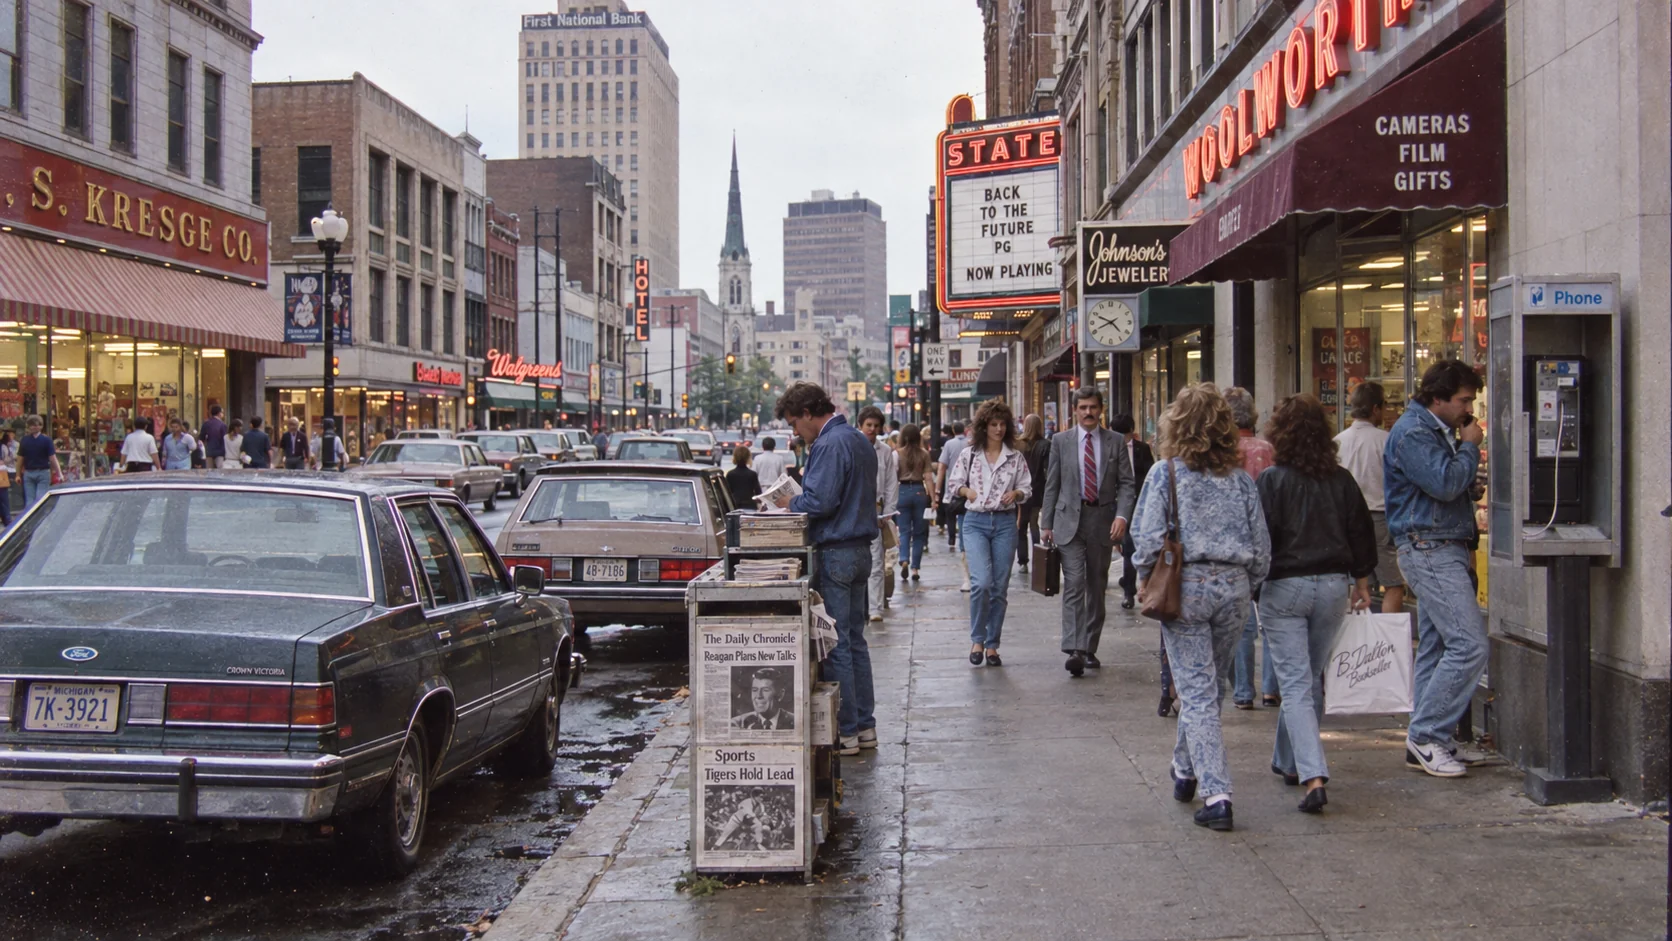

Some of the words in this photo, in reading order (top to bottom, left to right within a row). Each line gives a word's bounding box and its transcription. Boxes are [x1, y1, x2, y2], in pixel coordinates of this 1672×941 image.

[523, 14, 552, 28] First
[557, 12, 606, 27] National
[611, 12, 642, 25] Bank
[1375, 114, 1470, 136] CAMERAS
[948, 131, 1055, 167] STATE
[1399, 143, 1446, 163] FILM
[1394, 170, 1451, 192] GIFTS
[984, 185, 1020, 202] BACK
[32, 166, 68, 217] S.
[85, 181, 213, 254] KRESGE
[222, 224, 259, 265] CO.
[980, 206, 997, 220] TO
[1003, 203, 1028, 218] THE
[981, 221, 1034, 238] FUTURE
[994, 241, 1011, 254] PG
[1087, 231, 1167, 286] Johnson's
[966, 266, 994, 282] NOW
[1000, 262, 1053, 279] PLAYING
[1099, 267, 1170, 283] JEWELER
[635, 259, 648, 341] HOTEL
[1554, 290, 1603, 305] Phone
[927, 346, 945, 356] ONE
[487, 349, 562, 384] Walgreens
[927, 357, 946, 366] WAY
[704, 633, 722, 644] The
[725, 633, 750, 646] Daily
[753, 632, 796, 644] Chronicle
[69, 649, 90, 658] Ford
[704, 650, 734, 664] Reagan
[735, 650, 757, 662] Plans
[758, 650, 776, 662] New
[776, 650, 797, 661] Talks
[226, 666, 252, 675] CROWN
[254, 667, 286, 676] VICTORIA
[53, 686, 95, 696] MICHIGAN
[33, 696, 108, 722] 7K-3921
[714, 749, 756, 764] Sports
[704, 767, 737, 783] Tigers
[739, 767, 764, 781] Hold
[767, 767, 795, 780] Lead
